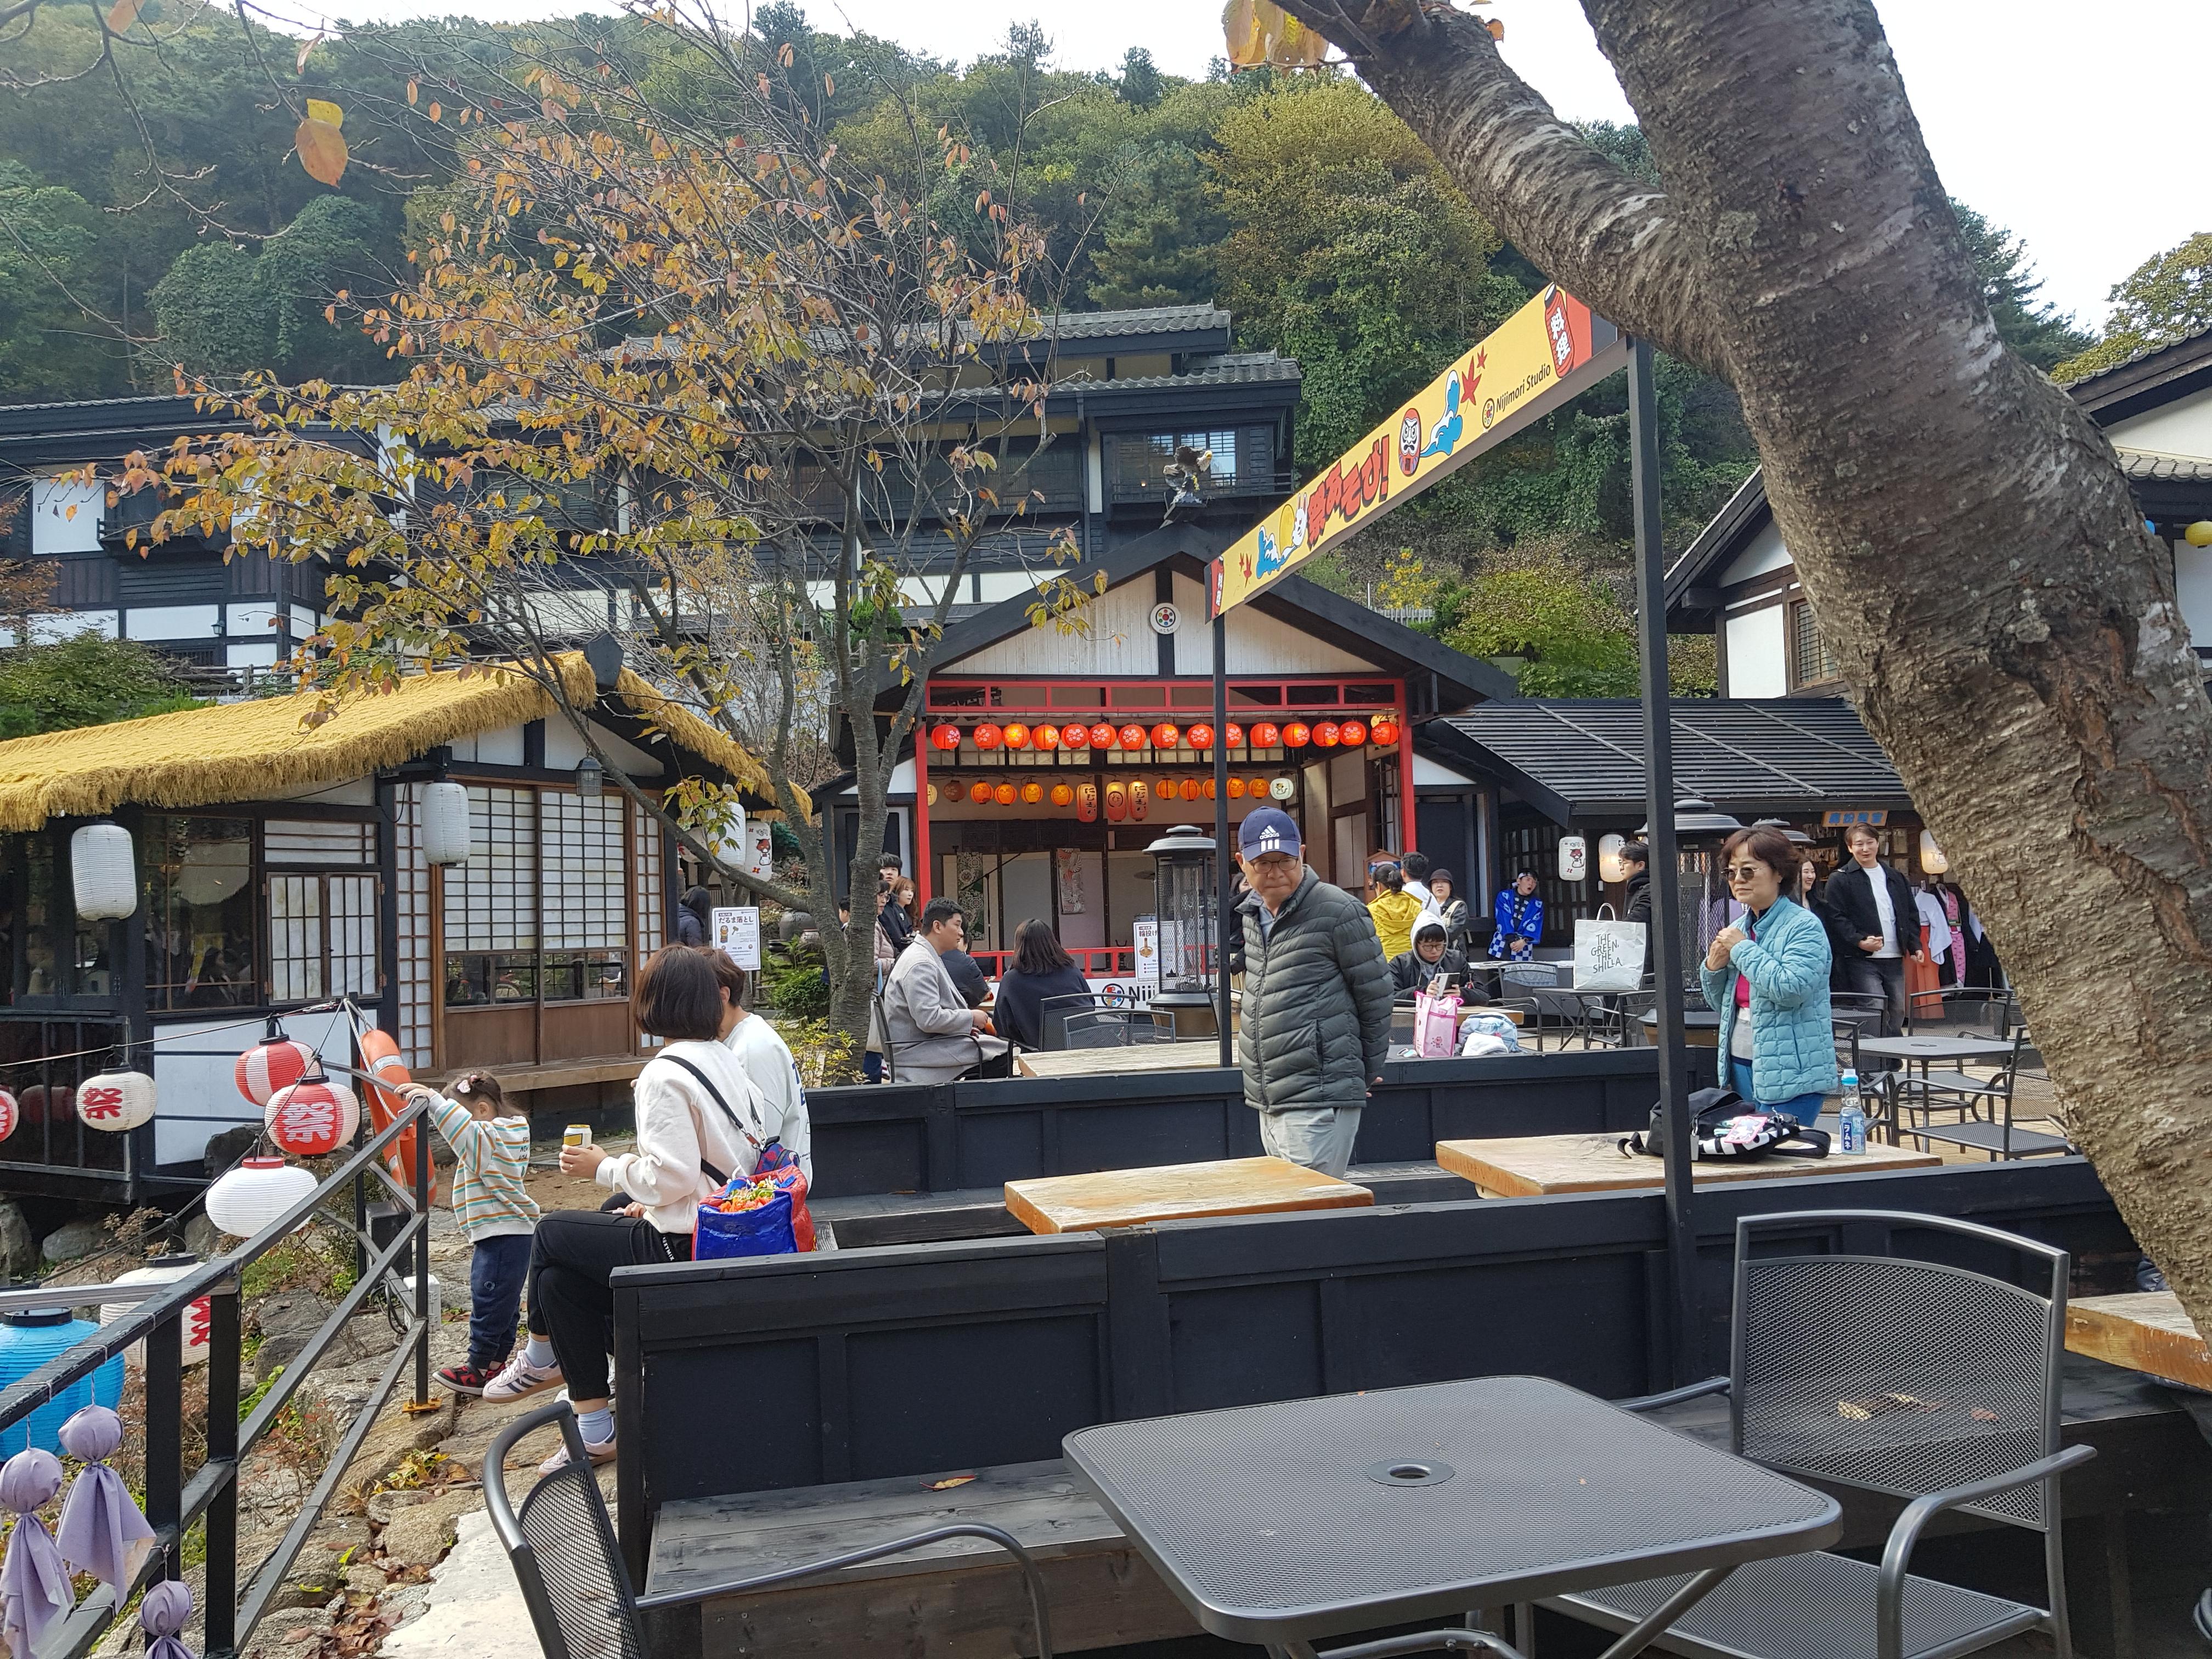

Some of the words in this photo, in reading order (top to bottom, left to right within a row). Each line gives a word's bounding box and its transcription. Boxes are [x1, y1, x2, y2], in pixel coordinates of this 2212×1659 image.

[1496, 379, 1525, 413] Nijimori
[1526, 363, 1551, 392] Studio
[1596, 933, 1611, 945] THE
[1593, 957, 1623, 974] SHILLA
[1596, 949, 1611, 963] THE
[83, 1087, 123, 1120] 祭
[283, 1102, 335, 1143] 祭
